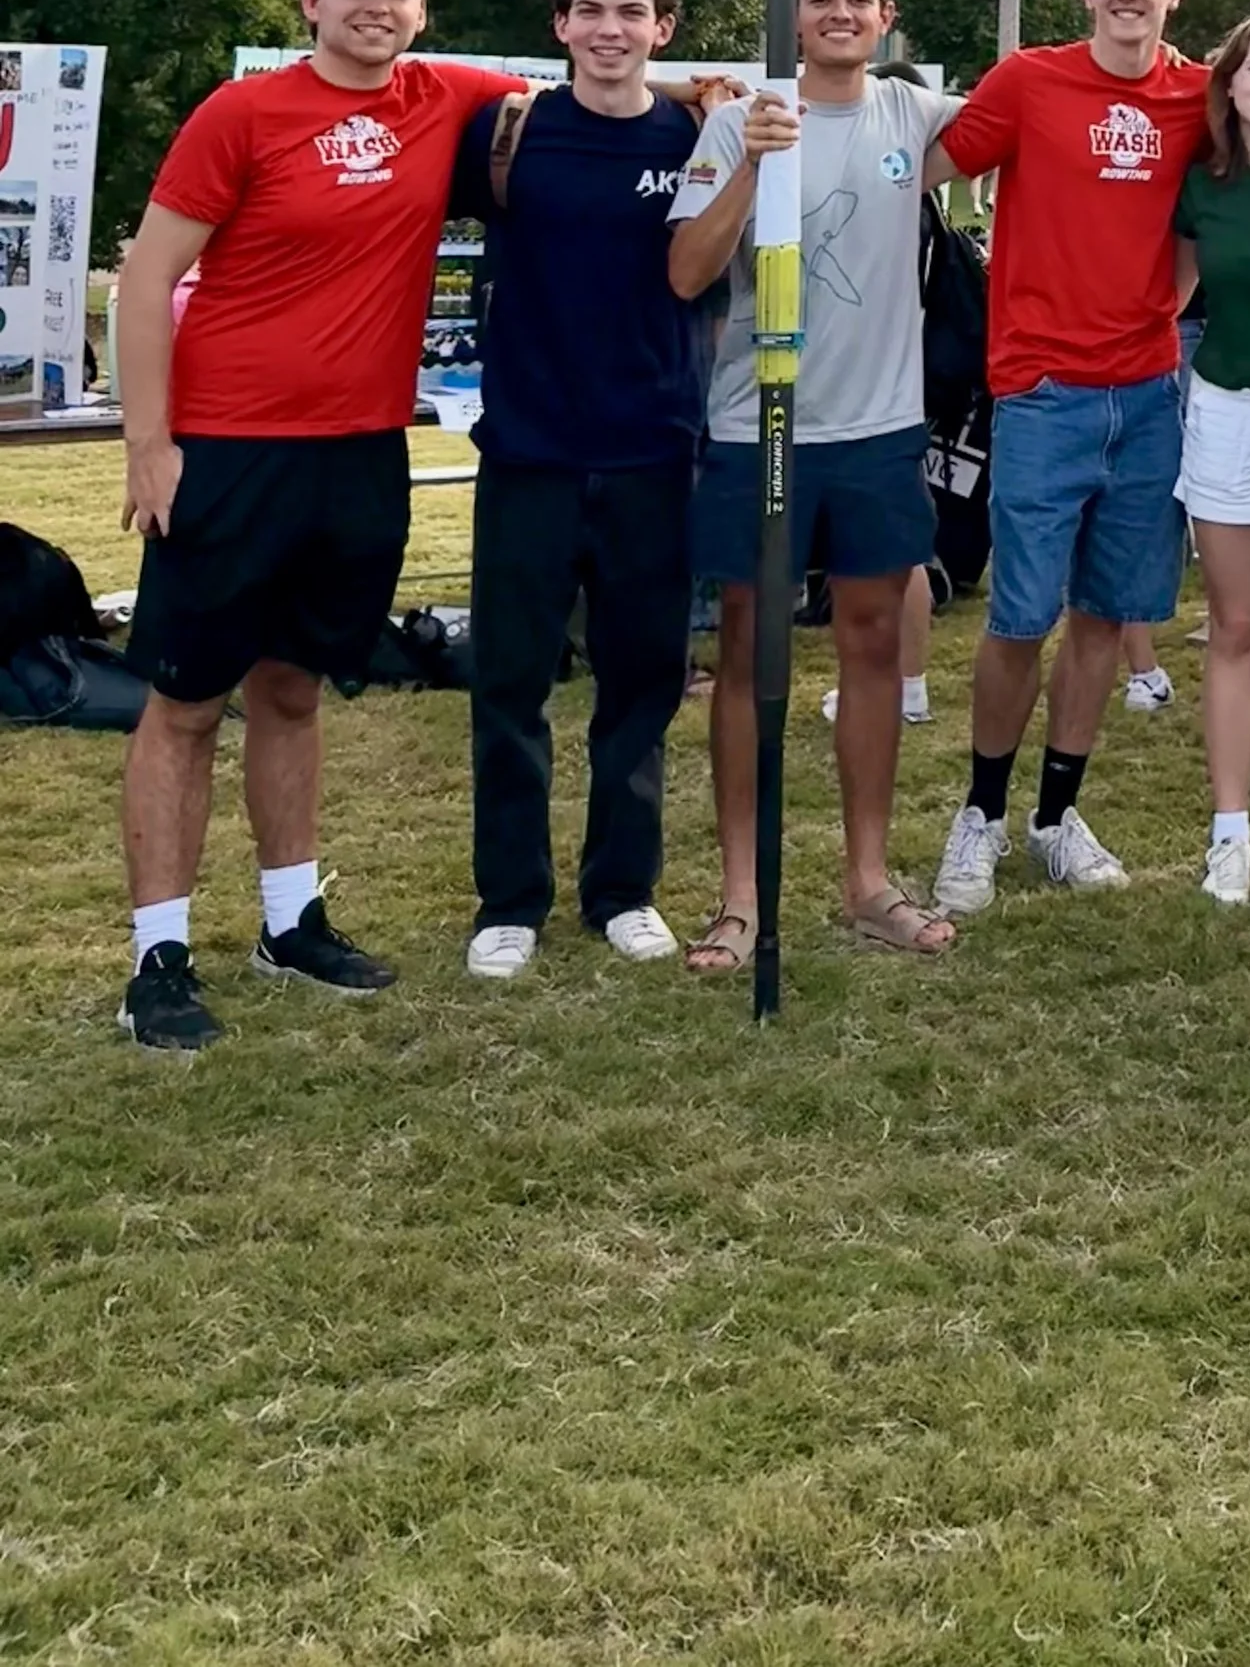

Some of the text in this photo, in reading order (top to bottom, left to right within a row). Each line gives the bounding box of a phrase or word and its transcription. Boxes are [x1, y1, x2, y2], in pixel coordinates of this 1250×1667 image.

[317, 135, 401, 162] WASH
[1091, 127, 1160, 156] WASH
[336, 167, 394, 186] ROWING
[1099, 167, 1153, 182] ROWING
